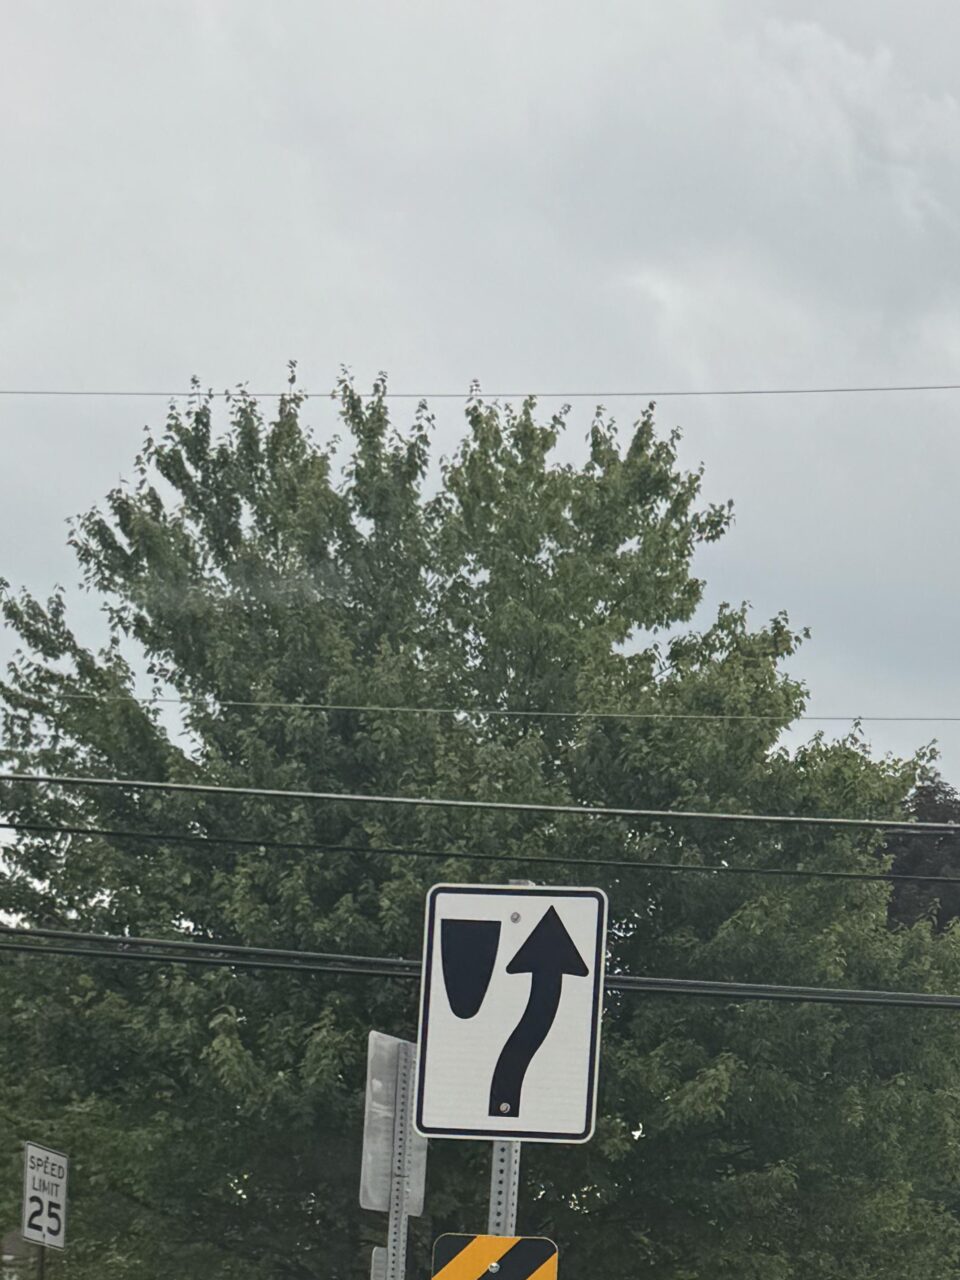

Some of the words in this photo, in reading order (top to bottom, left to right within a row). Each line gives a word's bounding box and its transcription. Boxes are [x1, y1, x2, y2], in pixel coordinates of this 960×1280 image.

[29, 1155, 65, 1180] SPEED
[32, 1176, 60, 1198] LIMIT
[27, 1195, 62, 1236] 25
